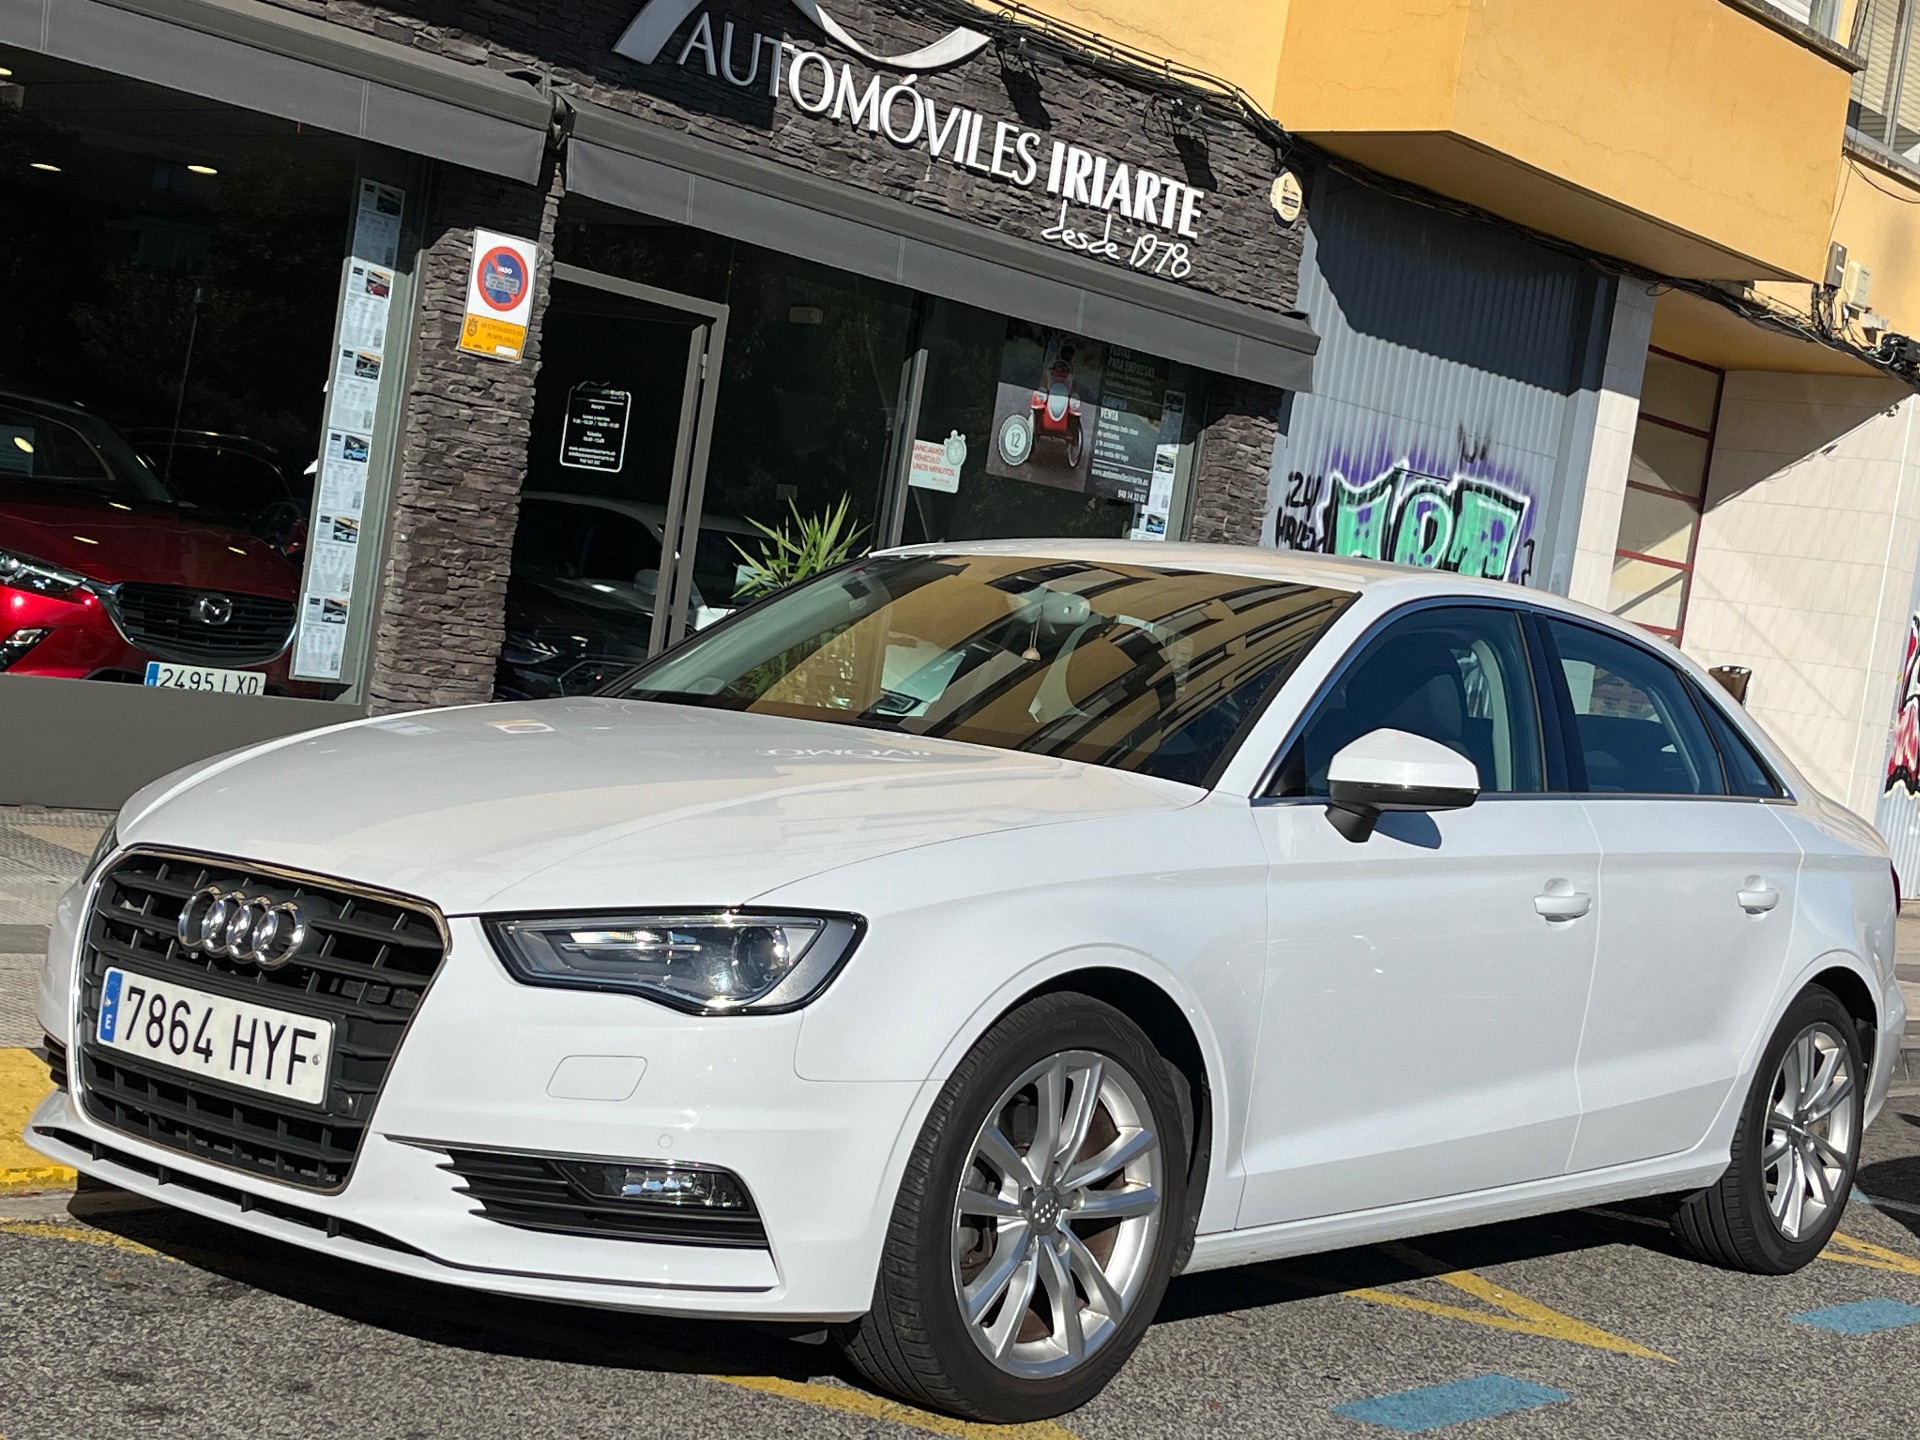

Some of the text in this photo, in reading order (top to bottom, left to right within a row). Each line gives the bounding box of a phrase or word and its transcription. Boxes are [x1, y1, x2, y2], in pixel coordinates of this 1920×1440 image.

[676, 12, 1204, 239] AUTOMÓVILES IRIARTE
[1041, 199, 1191, 278] desde 1978
[1011, 431, 1021, 448] 12
[1100, 407, 1119, 421] VENTA
[160, 668, 214, 692] 2495
[125, 985, 317, 1085] 7864 HYF
